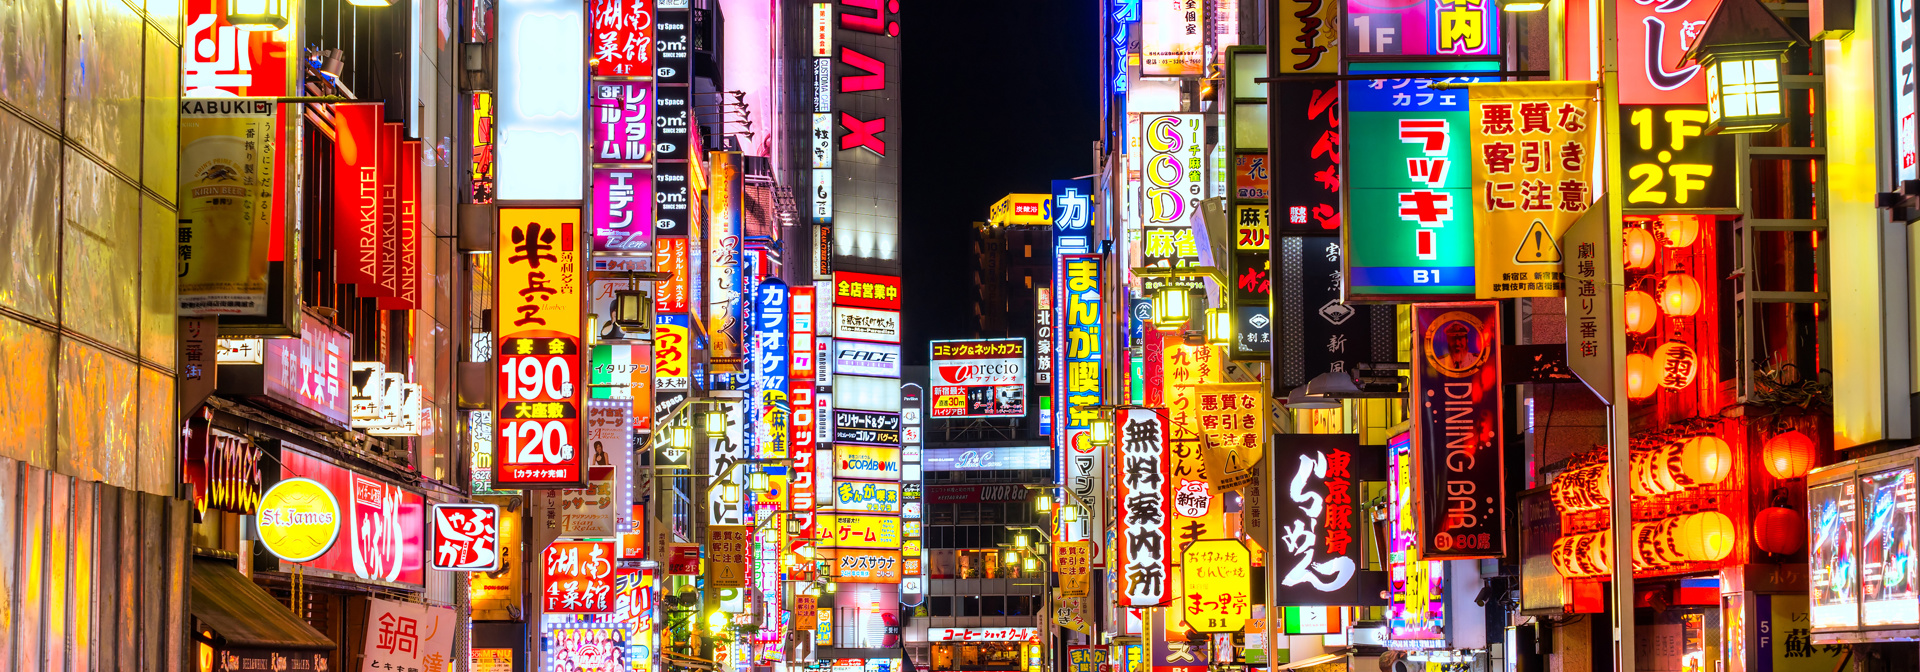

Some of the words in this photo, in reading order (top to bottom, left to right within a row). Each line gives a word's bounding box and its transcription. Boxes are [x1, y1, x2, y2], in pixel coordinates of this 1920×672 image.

[596, 0, 651, 31] 湖南
[1353, 15, 1396, 53] 1F
[613, 64, 634, 74] 4F
[820, 60, 829, 92] CUSTOMA
[601, 86, 621, 98] 3F
[1392, 93, 1457, 106] カフェ
[820, 94, 829, 110] CAFE
[625, 85, 646, 160] レンタル
[1480, 101, 1587, 135] 悪質な
[601, 104, 621, 159] ルーム
[1630, 108, 1708, 151] 1F
[1188, 119, 1201, 182] リーチ麻雀
[1481, 140, 1586, 174] 客引き
[1248, 158, 1268, 180] 花
[194, 187, 220, 197] KIRIN
[222, 186, 244, 196] BEER
[1399, 118, 1453, 261] ラッキー
[1628, 163, 1713, 204] 2F
[609, 172, 634, 229] エデン
[1485, 179, 1589, 213] に注意
[360, 166, 376, 277] ANRAKUTEI
[381, 184, 396, 291] ANRAKUTEI
[605, 231, 648, 250] Eden
[1145, 228, 1199, 258] 麻雀
[401, 201, 415, 303] ANRAKUTEI
[608, 260, 647, 271] タイ古式
[1413, 269, 1440, 283] B1
[1503, 272, 1527, 281] 新宿区
[676, 285, 684, 308] ホステル
[838, 280, 897, 301] 全店営業中
[1577, 241, 1598, 357] 劇場通り一番街
[658, 316, 674, 324] 1F
[762, 285, 784, 373] カラオケ
[1247, 332, 1270, 343] 割烹
[517, 338, 566, 353] 宴会
[1037, 310, 1051, 371] 北の家族
[1067, 260, 1099, 427] まんが喫茶
[838, 350, 898, 363] FACE
[934, 344, 1023, 356] コミック&ネットカフェ
[281, 344, 298, 391] 焼肉
[594, 364, 650, 374] イタリアン
[818, 352, 827, 382] MARUHAN
[955, 360, 1019, 382] aprecio
[1664, 346, 1694, 388] 手羽先
[763, 375, 785, 389] 747
[934, 387, 966, 396] 新宿最大
[516, 402, 564, 419] 大座敷
[973, 402, 994, 410] ダーツ
[1202, 394, 1255, 410] 悪質な
[590, 408, 624, 417] タイ古式
[933, 408, 966, 416] ハイジアB1
[818, 408, 827, 438] MARUHAN
[837, 413, 899, 429] ビリヤード&ダーツ
[1202, 413, 1256, 430] 客引き
[1444, 382, 1476, 473] DINING
[771, 410, 785, 452] 麻雀
[856, 430, 877, 442] ゴルフ
[877, 433, 899, 442] バグース
[1205, 433, 1258, 449] に注意
[668, 449, 680, 457] B1
[838, 483, 897, 504] まんが喫茶
[980, 486, 1010, 501] LUXOR
[1011, 484, 1029, 500] Bar
[1177, 492, 1208, 508] 新宿
[1124, 418, 1163, 597] 無料案内所
[1324, 448, 1352, 556] 東京豚骨
[1447, 480, 1477, 529] BAR
[1187, 507, 1198, 516] の
[712, 531, 743, 541] 悪質な
[838, 525, 877, 542] ゲーム
[1436, 535, 1451, 549] B1
[1457, 533, 1491, 550] 80席
[712, 543, 743, 552] 客引き
[1058, 547, 1086, 555] 悪質な
[548, 543, 612, 579] 湖南
[712, 554, 743, 563] に注意
[841, 556, 896, 569] メンズサウナ
[1059, 557, 1086, 565] 客引き
[1188, 551, 1238, 563] お好み焼
[685, 564, 698, 572] 2F
[1059, 567, 1087, 575] に注意
[1197, 566, 1245, 578] もんじゃ焼
[1188, 592, 1247, 615] まつ里亭
[1208, 618, 1227, 627] B1
[376, 612, 419, 660] 鍋
[942, 629, 981, 640] コーヒー
[984, 630, 1007, 639] ショップ
[1008, 628, 1029, 640] クール
[1760, 621, 1770, 648] 5F
[483, 649, 511, 658] MENU
